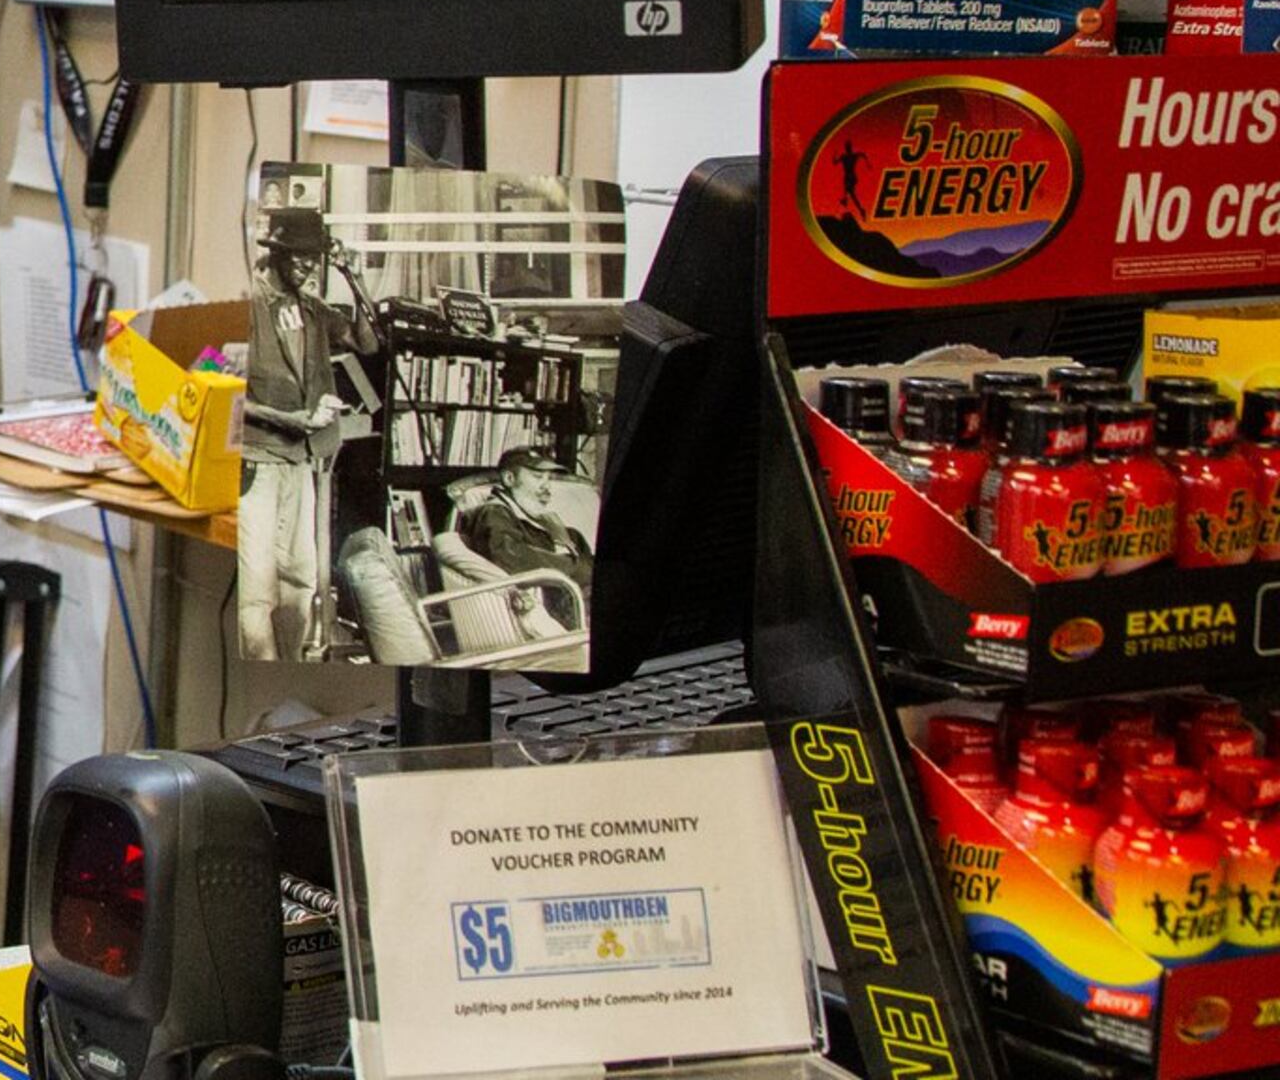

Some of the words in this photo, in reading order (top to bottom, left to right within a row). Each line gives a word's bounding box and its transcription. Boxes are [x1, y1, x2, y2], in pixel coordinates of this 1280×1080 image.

[916, 0, 958, 17] Tablets,
[960, 1, 982, 16] 200
[983, 4, 1002, 18] mg
[861, 14, 885, 29] Pain
[968, 18, 1013, 32] Reducer
[1015, 17, 1061, 35] (NSAID)
[1172, 21, 1210, 35] Extra
[1075, 38, 1110, 49] Tablets
[1118, 77, 1279, 150] Hours
[899, 104, 1022, 164] 5-hour
[874, 161, 1049, 221] ENERGY
[1116, 172, 1190, 246] No
[1153, 334, 1218, 356] LEMONADE
[1102, 423, 1147, 443] Berry
[974, 614, 1022, 636] Berry
[1126, 602, 1237, 637] EXTRA
[1125, 631, 1237, 657] STRENGTH
[450, 826, 523, 846] DONATE
[527, 825, 550, 841] TO
[556, 822, 586, 839] THE
[590, 817, 699, 838] COMMUNITY
[790, 721, 897, 966] 5-hour
[491, 851, 574, 871] VOUCHER
[579, 846, 666, 866] PROGRAM
[542, 895, 669, 924] BIGMOUTHBEN
[286, 937, 318, 955] GAS
[460, 904, 514, 974] $5
[455, 1001, 508, 1016] Uplifting
[510, 999, 534, 1011] and
[536, 997, 580, 1012] Serving
[582, 994, 601, 1007] the
[605, 990, 670, 1007] Community
[673, 987, 701, 1000] since
[704, 986, 733, 1000] 2014
[1093, 987, 1144, 1015] Berry
